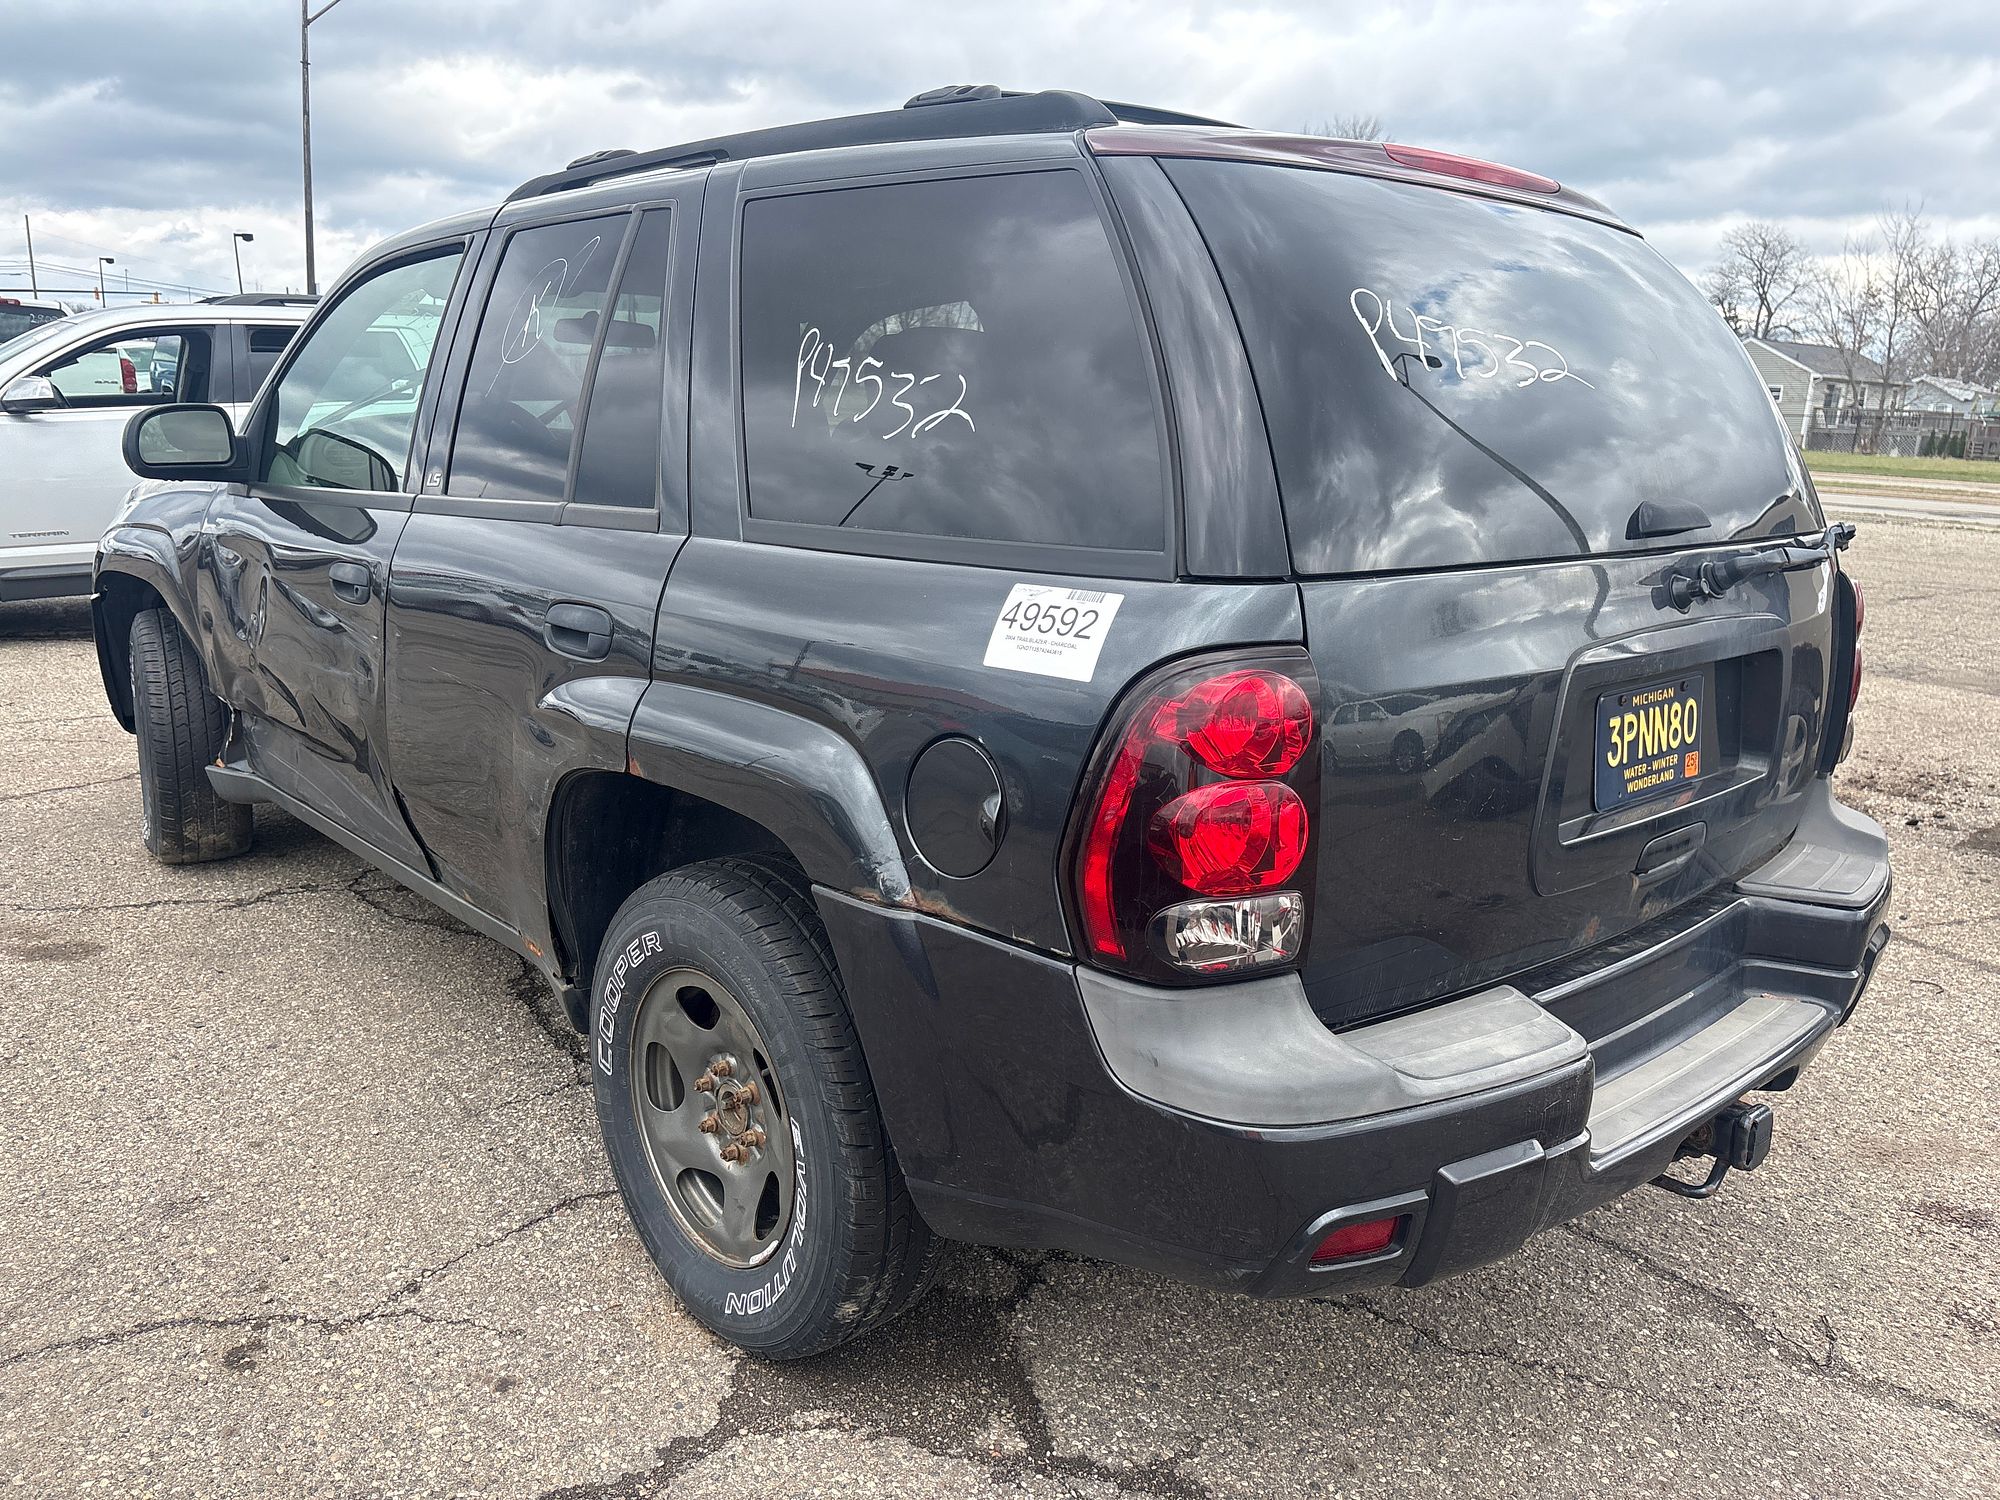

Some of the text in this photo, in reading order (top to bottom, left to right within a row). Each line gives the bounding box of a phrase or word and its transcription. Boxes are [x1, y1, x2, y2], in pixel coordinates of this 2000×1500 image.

[426, 473, 442, 487] LS
[8, 529, 70, 538] TERRAIN
[1001, 601, 1099, 640] 49592
[1016, 635, 1048, 645] TRAILBLAZER
[1632, 687, 1675, 707] MICHIGAN
[1607, 697, 1698, 768] 3PNN80
[1623, 763, 1647, 780] WATER
[1652, 754, 1679, 771] WINTER
[1626, 769, 1675, 794] WONDERLAND
[597, 931, 664, 1076] COOPER
[724, 1116, 808, 1316] EVOLUTION
